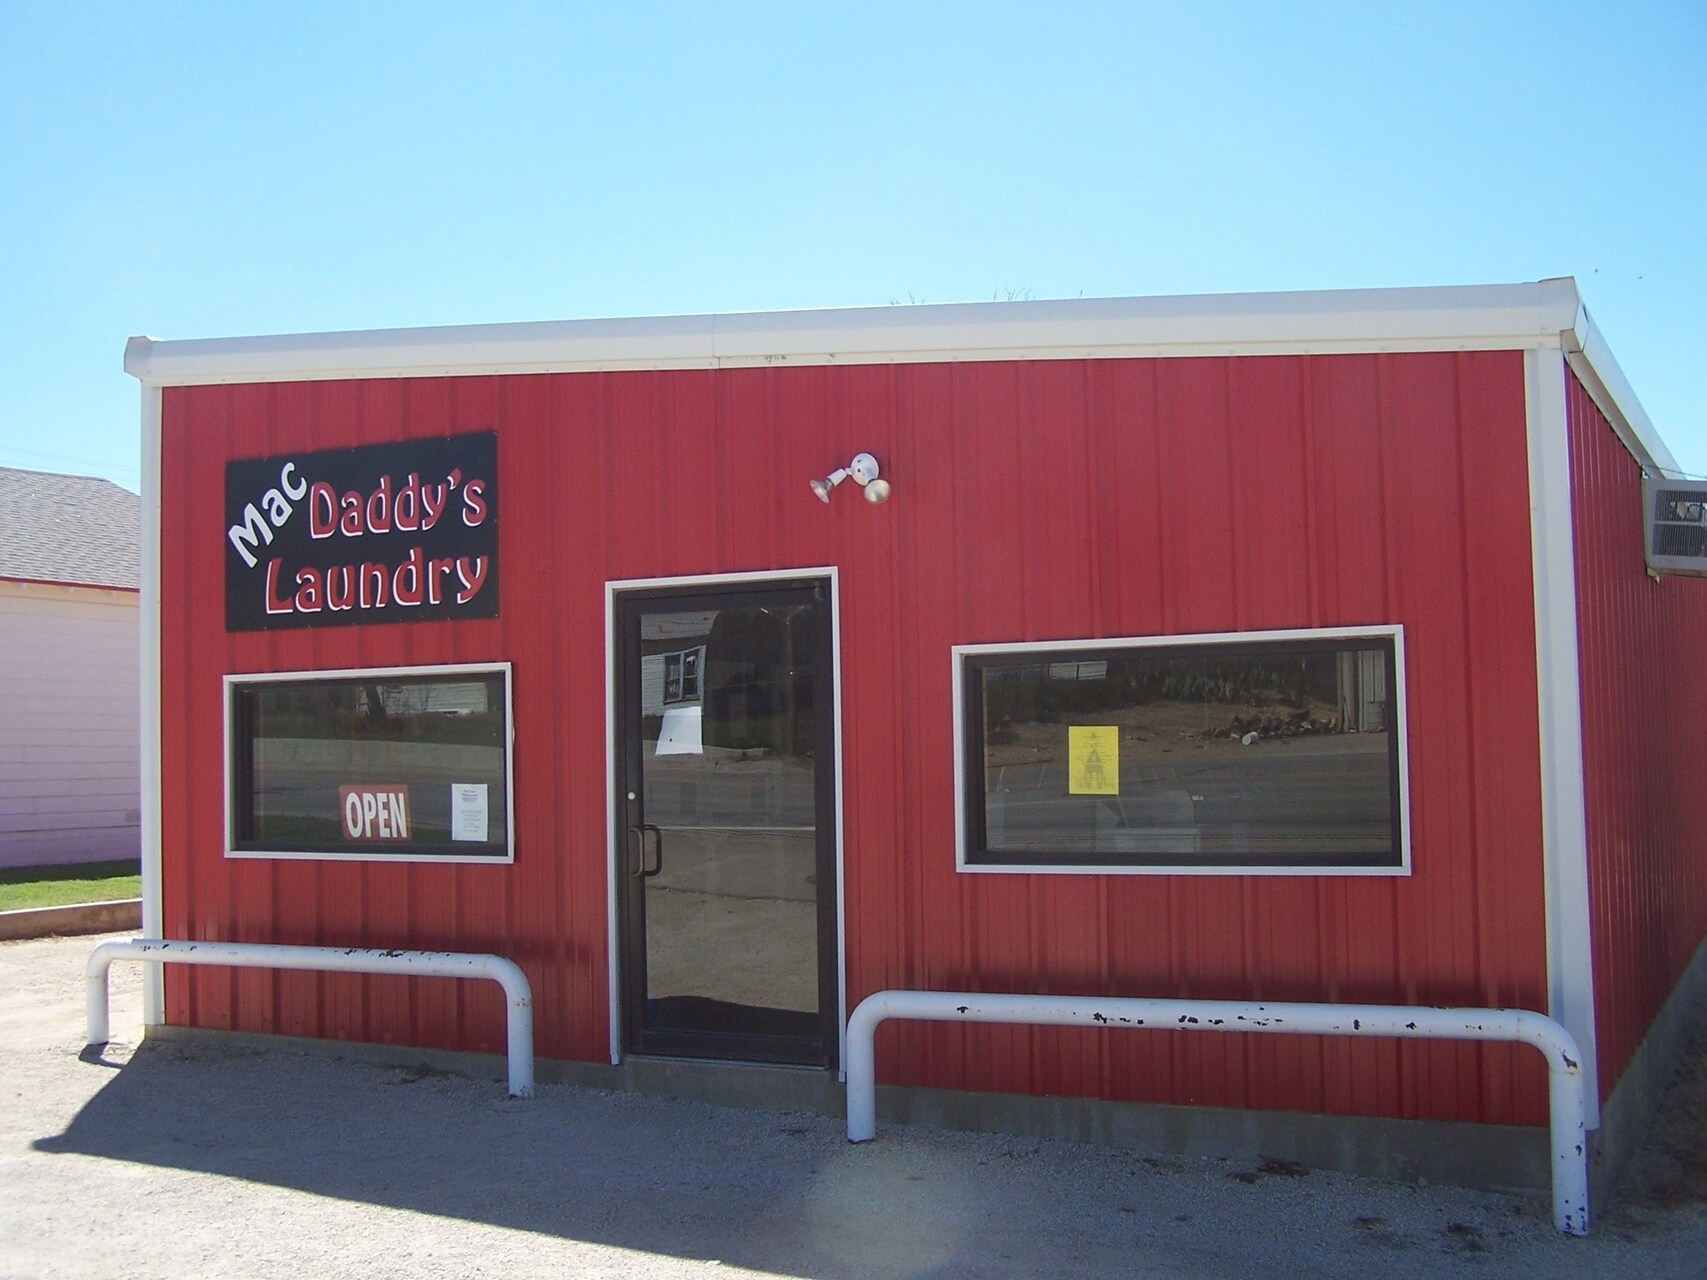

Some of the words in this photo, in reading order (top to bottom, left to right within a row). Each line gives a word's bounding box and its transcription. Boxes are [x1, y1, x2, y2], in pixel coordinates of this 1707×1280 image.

[228, 462, 307, 568] Mac
[310, 467, 487, 539] Daddy's
[265, 546, 489, 615] Laundry
[345, 792, 408, 838] OPEN
